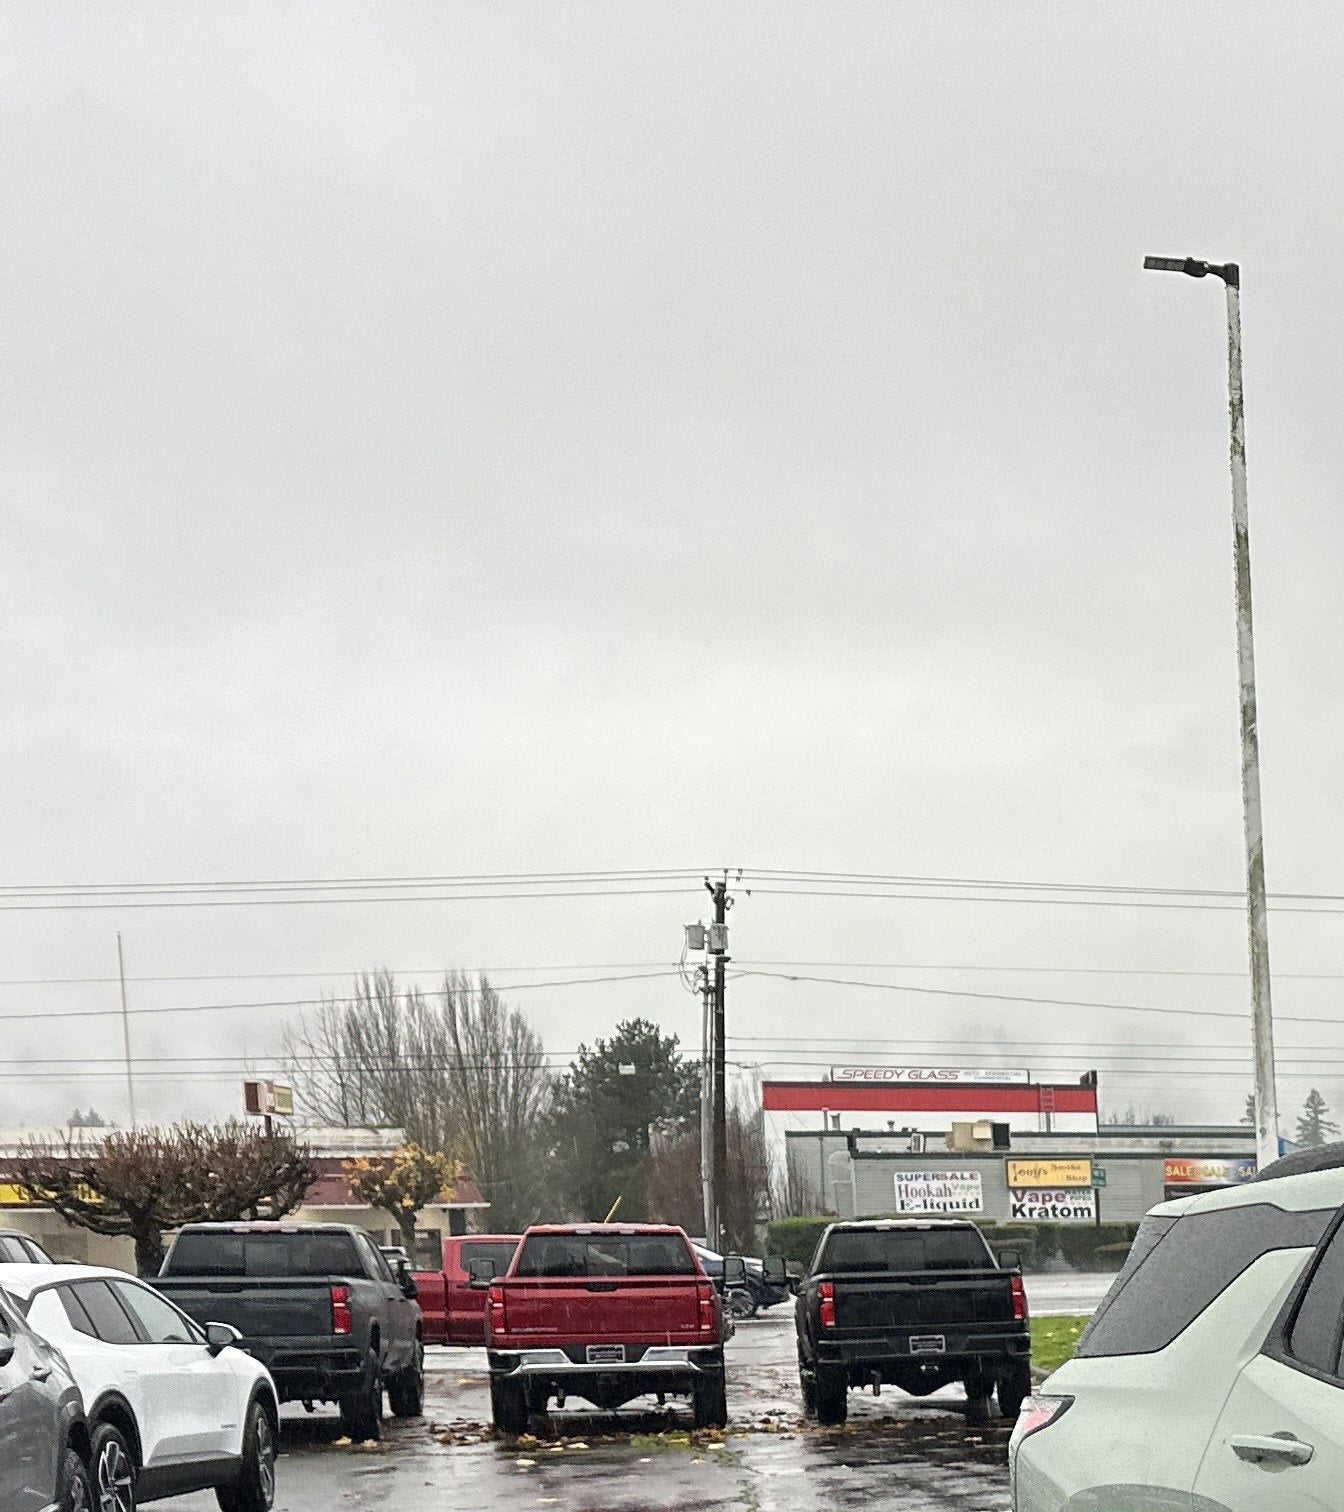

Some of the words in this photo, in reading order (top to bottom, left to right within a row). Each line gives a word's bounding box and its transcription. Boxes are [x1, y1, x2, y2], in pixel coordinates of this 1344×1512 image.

[837, 1069, 904, 1080] SPEEDY
[907, 1070, 960, 1081] GLASS
[1166, 1166, 1195, 1177] SALE
[1238, 1166, 1257, 1178] SAL
[898, 1183, 952, 1199] Hookah
[1011, 1189, 1066, 1205] Vape
[900, 1198, 980, 1212] E-liquid
[1012, 1203, 1092, 1218] Kratom
